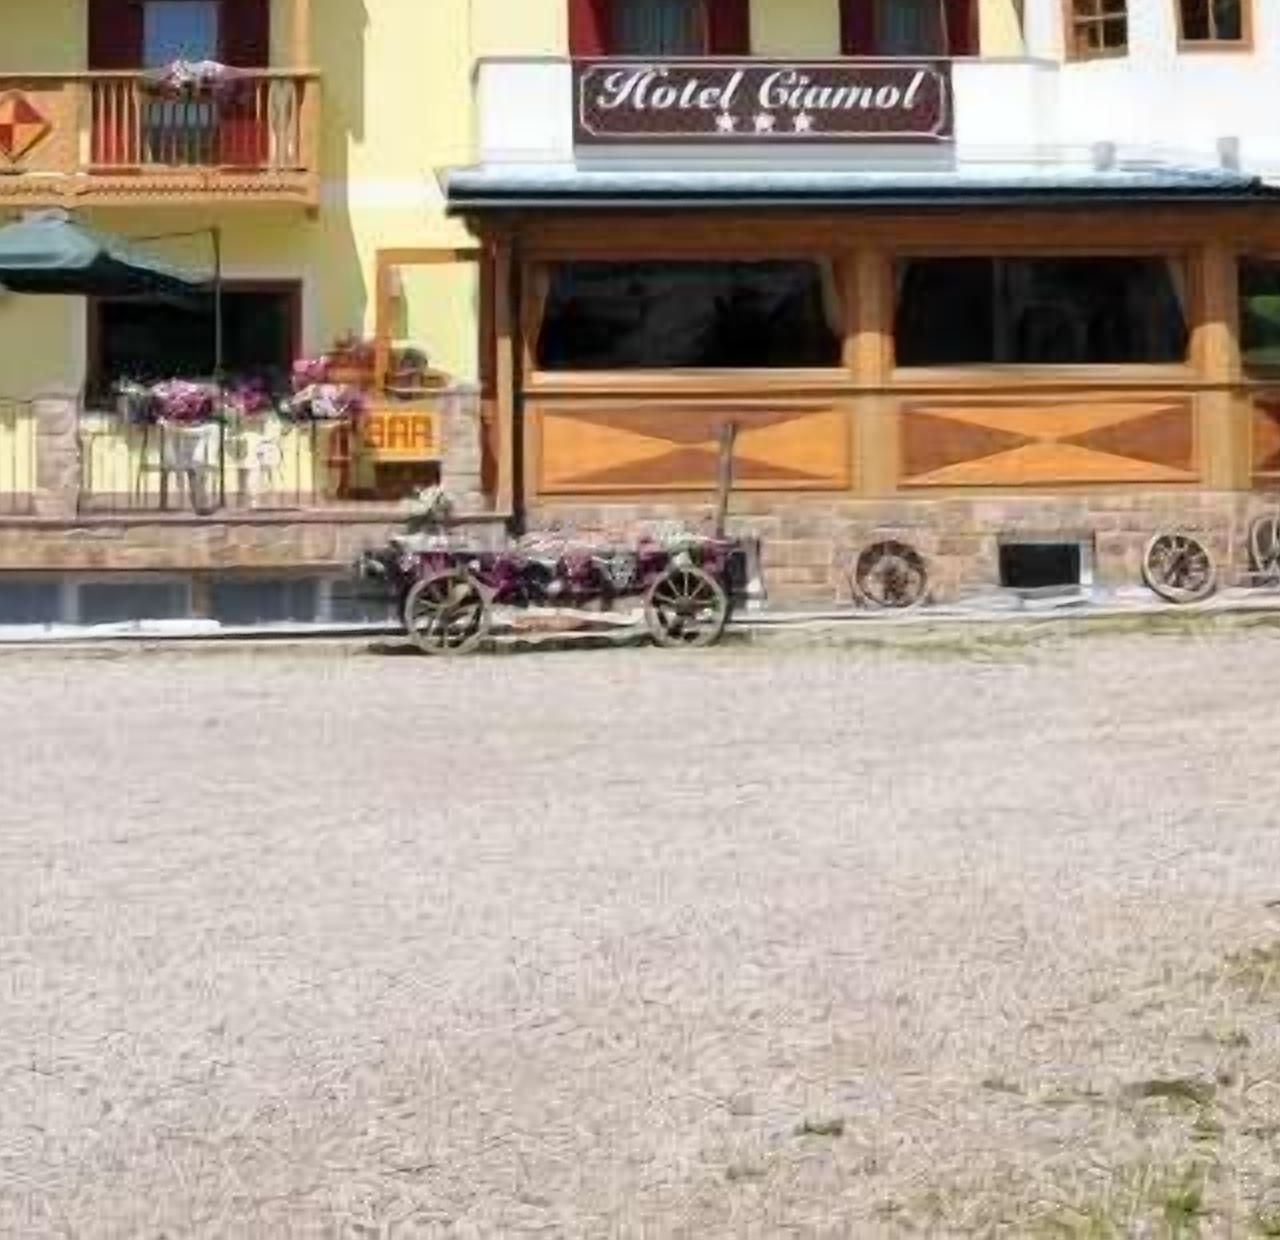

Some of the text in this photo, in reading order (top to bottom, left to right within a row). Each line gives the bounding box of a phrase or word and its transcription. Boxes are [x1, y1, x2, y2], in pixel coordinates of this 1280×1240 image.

[596, 67, 925, 110] Hotel Ciamol
[363, 415, 433, 448] BAR
